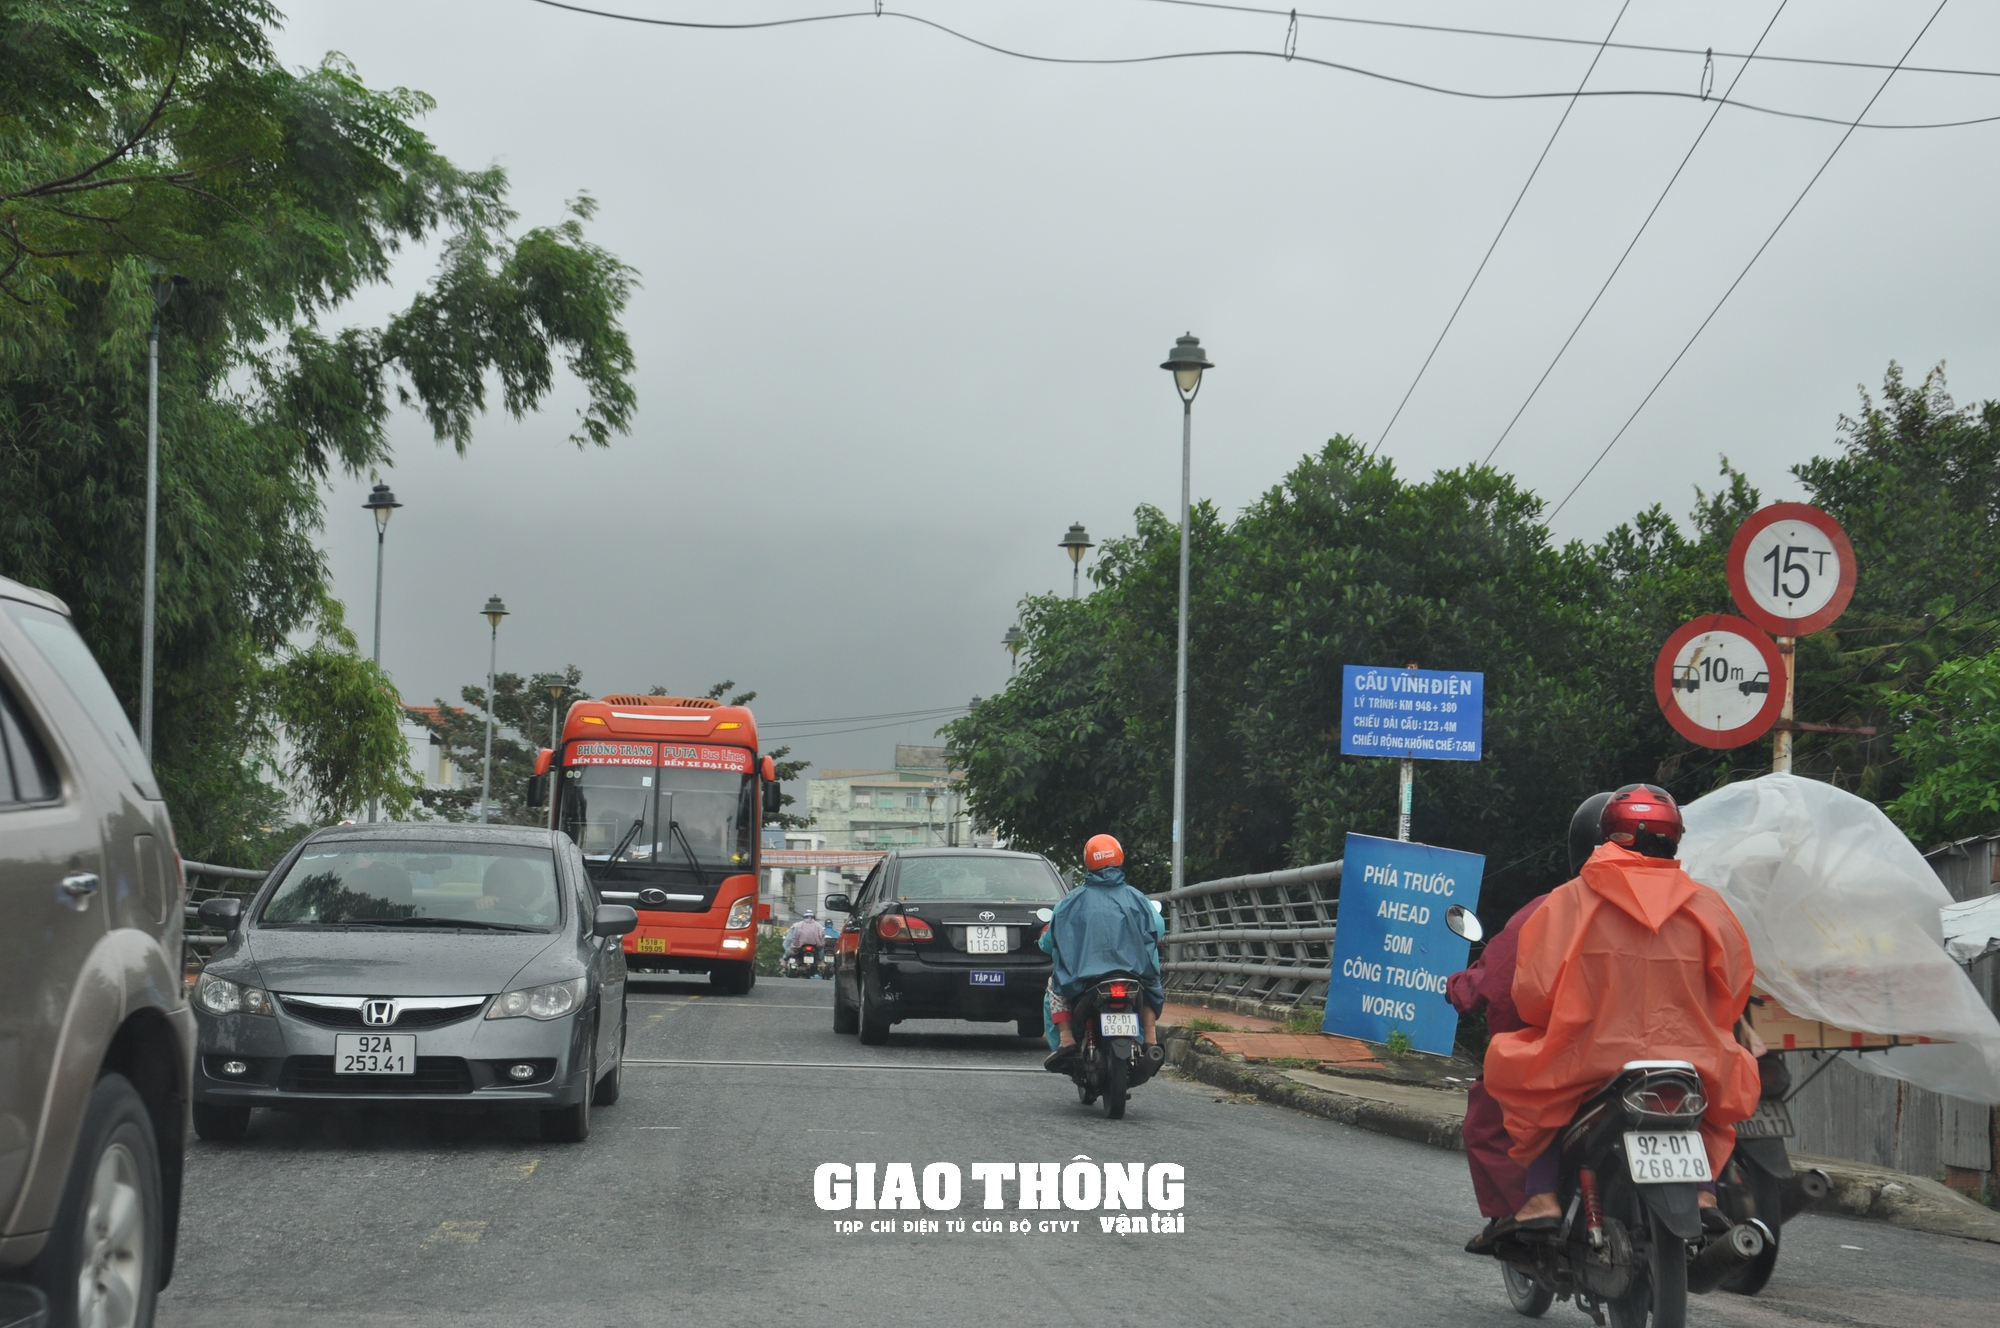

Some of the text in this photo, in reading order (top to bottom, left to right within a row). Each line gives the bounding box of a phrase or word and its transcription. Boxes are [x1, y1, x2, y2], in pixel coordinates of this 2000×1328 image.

[1355, 670, 1471, 698] CẦU VĨNH ĐIỆN
[1354, 694, 1366, 708] LÝ
[1399, 700, 1413, 711] KM
[1440, 702, 1457, 714] 380
[619, 745, 654, 757] TRANG
[1380, 734, 1403, 750] RỘNG
[1404, 735, 1434, 750] KHỐNG
[664, 746, 746, 763] FUTA Bus Lines
[1364, 863, 1455, 897] PHÍA TRƯỚC
[1377, 900, 1430, 925] AHEAD
[976, 926, 997, 939] 92A
[969, 940, 1006, 952] 115.68
[1383, 934, 1413, 955] 50M
[1343, 956, 1447, 995] CÔNG TRƯỜNG
[1361, 994, 1416, 1021] WORKS
[1104, 1025, 1137, 1035] 858.70
[359, 1037, 392, 1053] 92A
[344, 1055, 405, 1072] 253.41
[1638, 1136, 1691, 1156] 92-D1
[1636, 1158, 1705, 1180] 268.28
